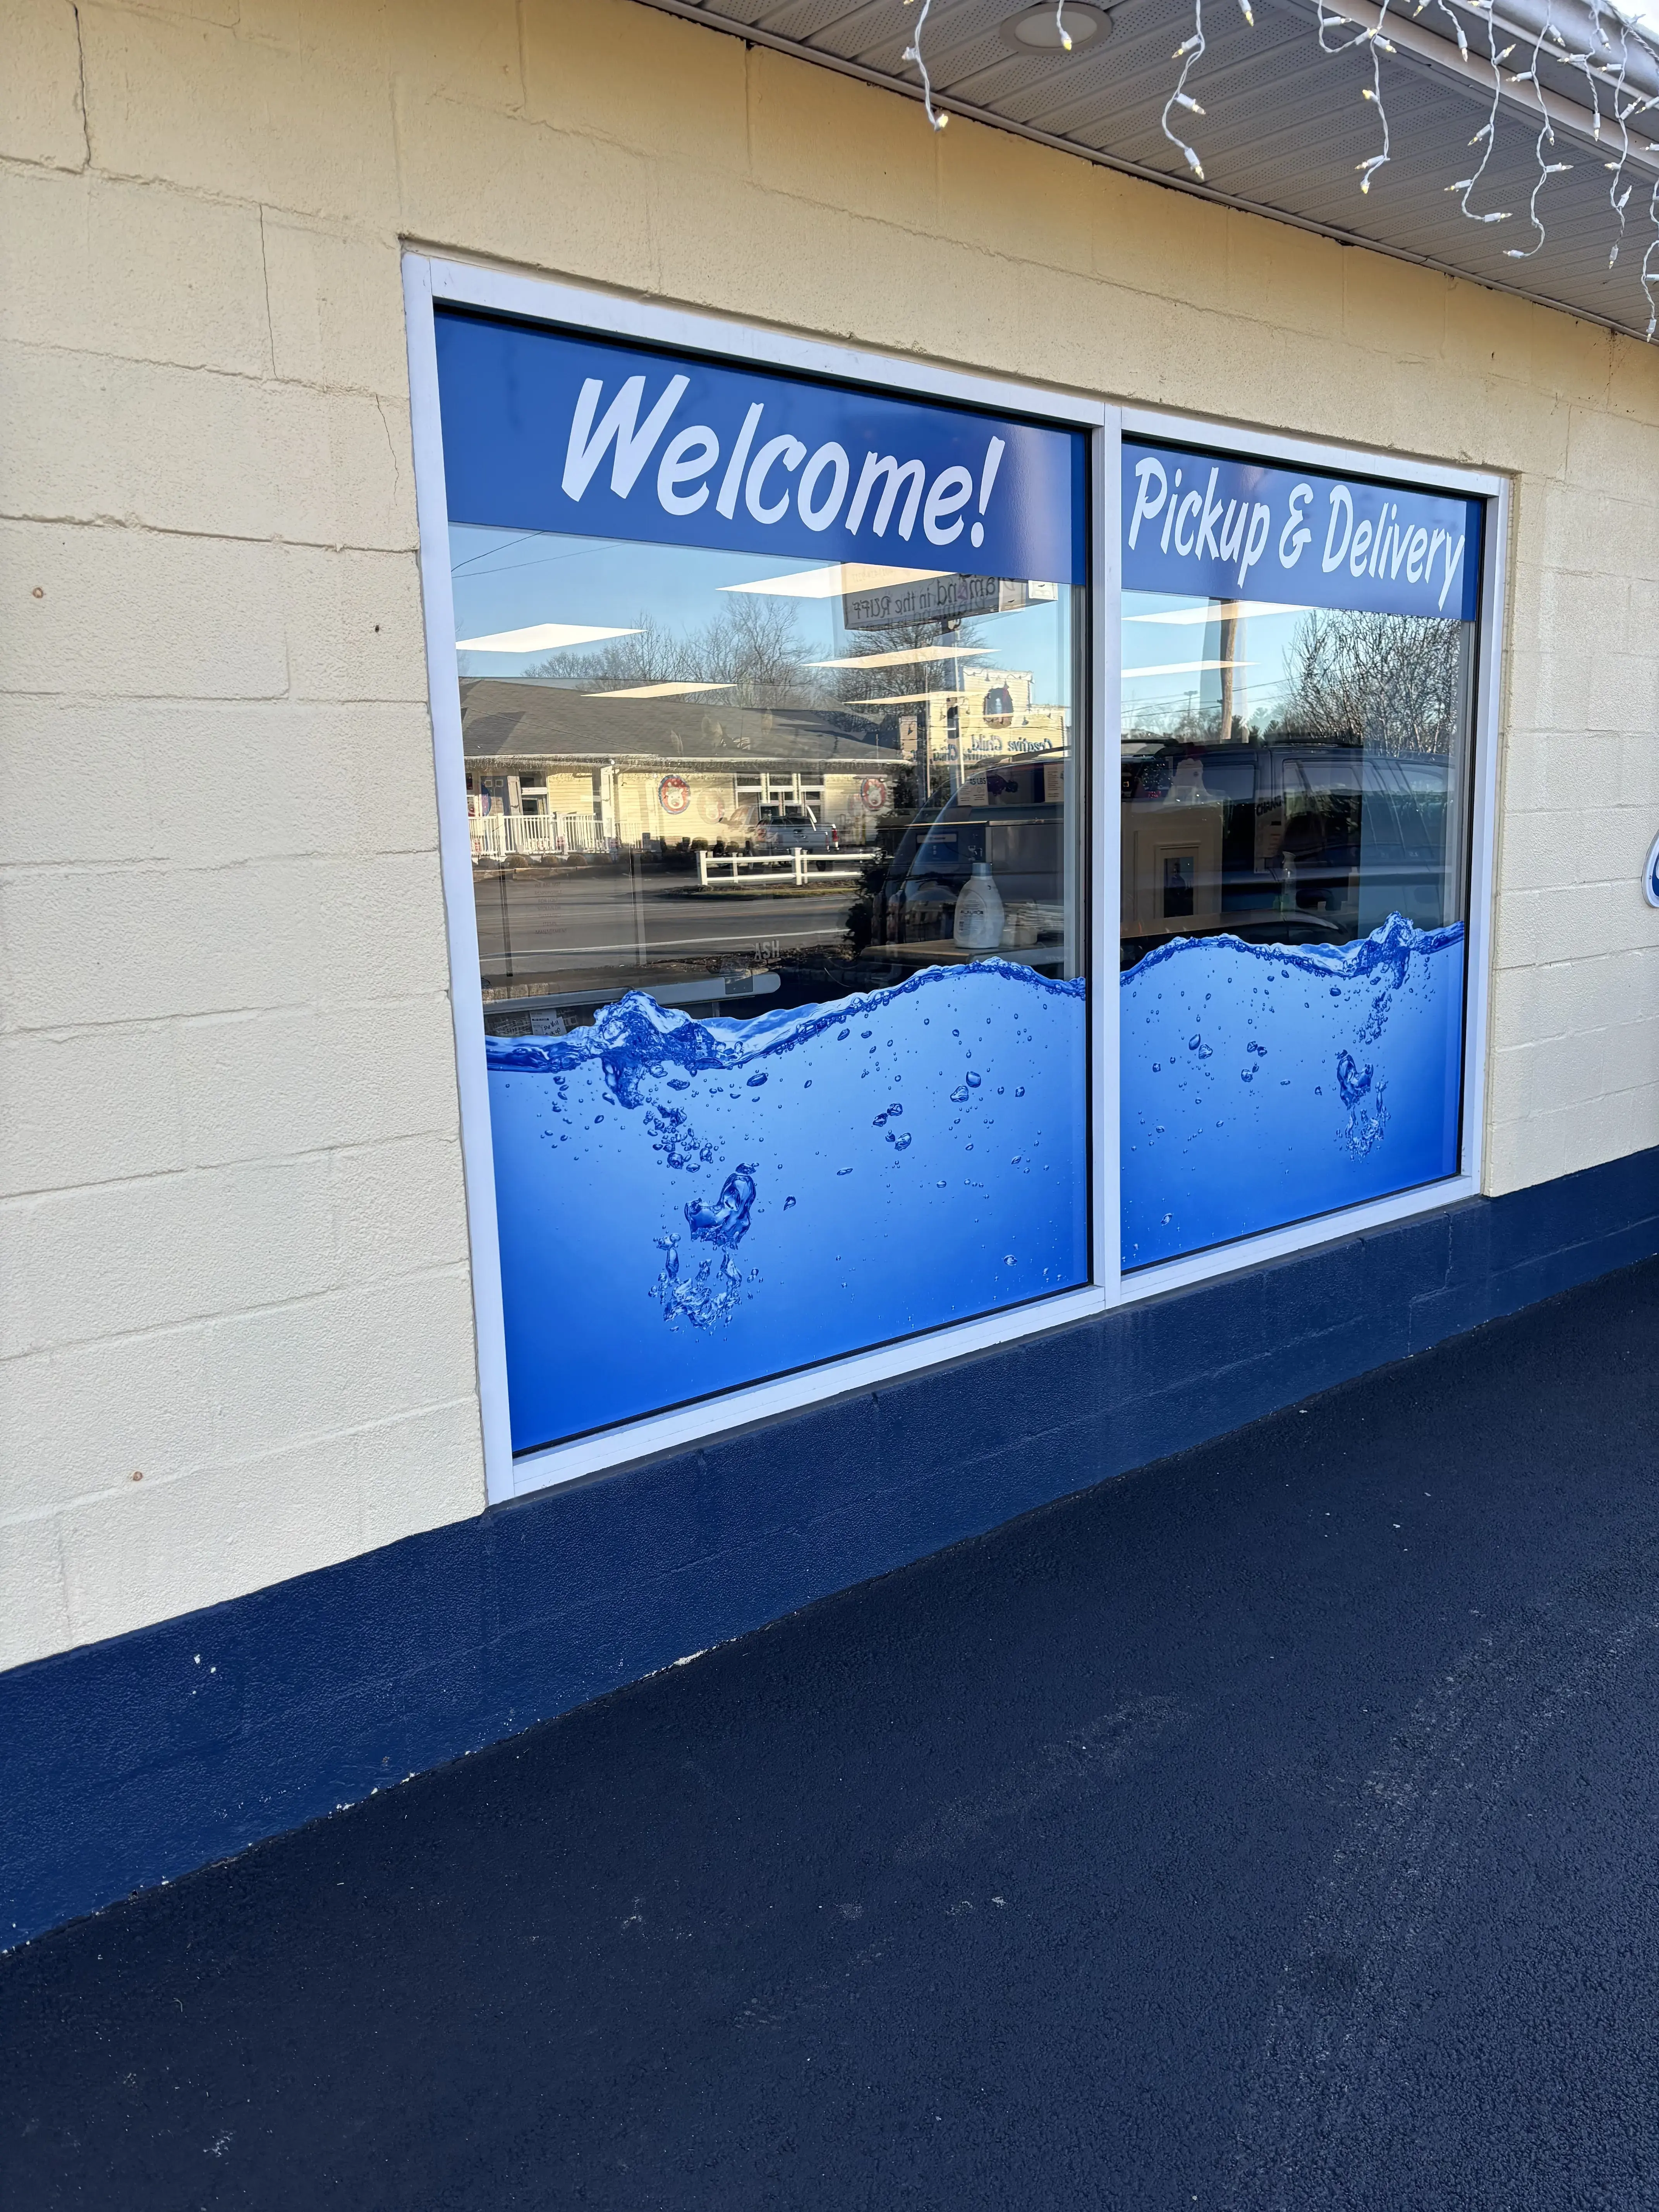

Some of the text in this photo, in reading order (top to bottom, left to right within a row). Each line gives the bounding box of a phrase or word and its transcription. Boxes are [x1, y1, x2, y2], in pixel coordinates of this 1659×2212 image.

[561, 374, 1005, 548] Welcome!
[1128, 457, 1465, 611] Pickup & Delivery
